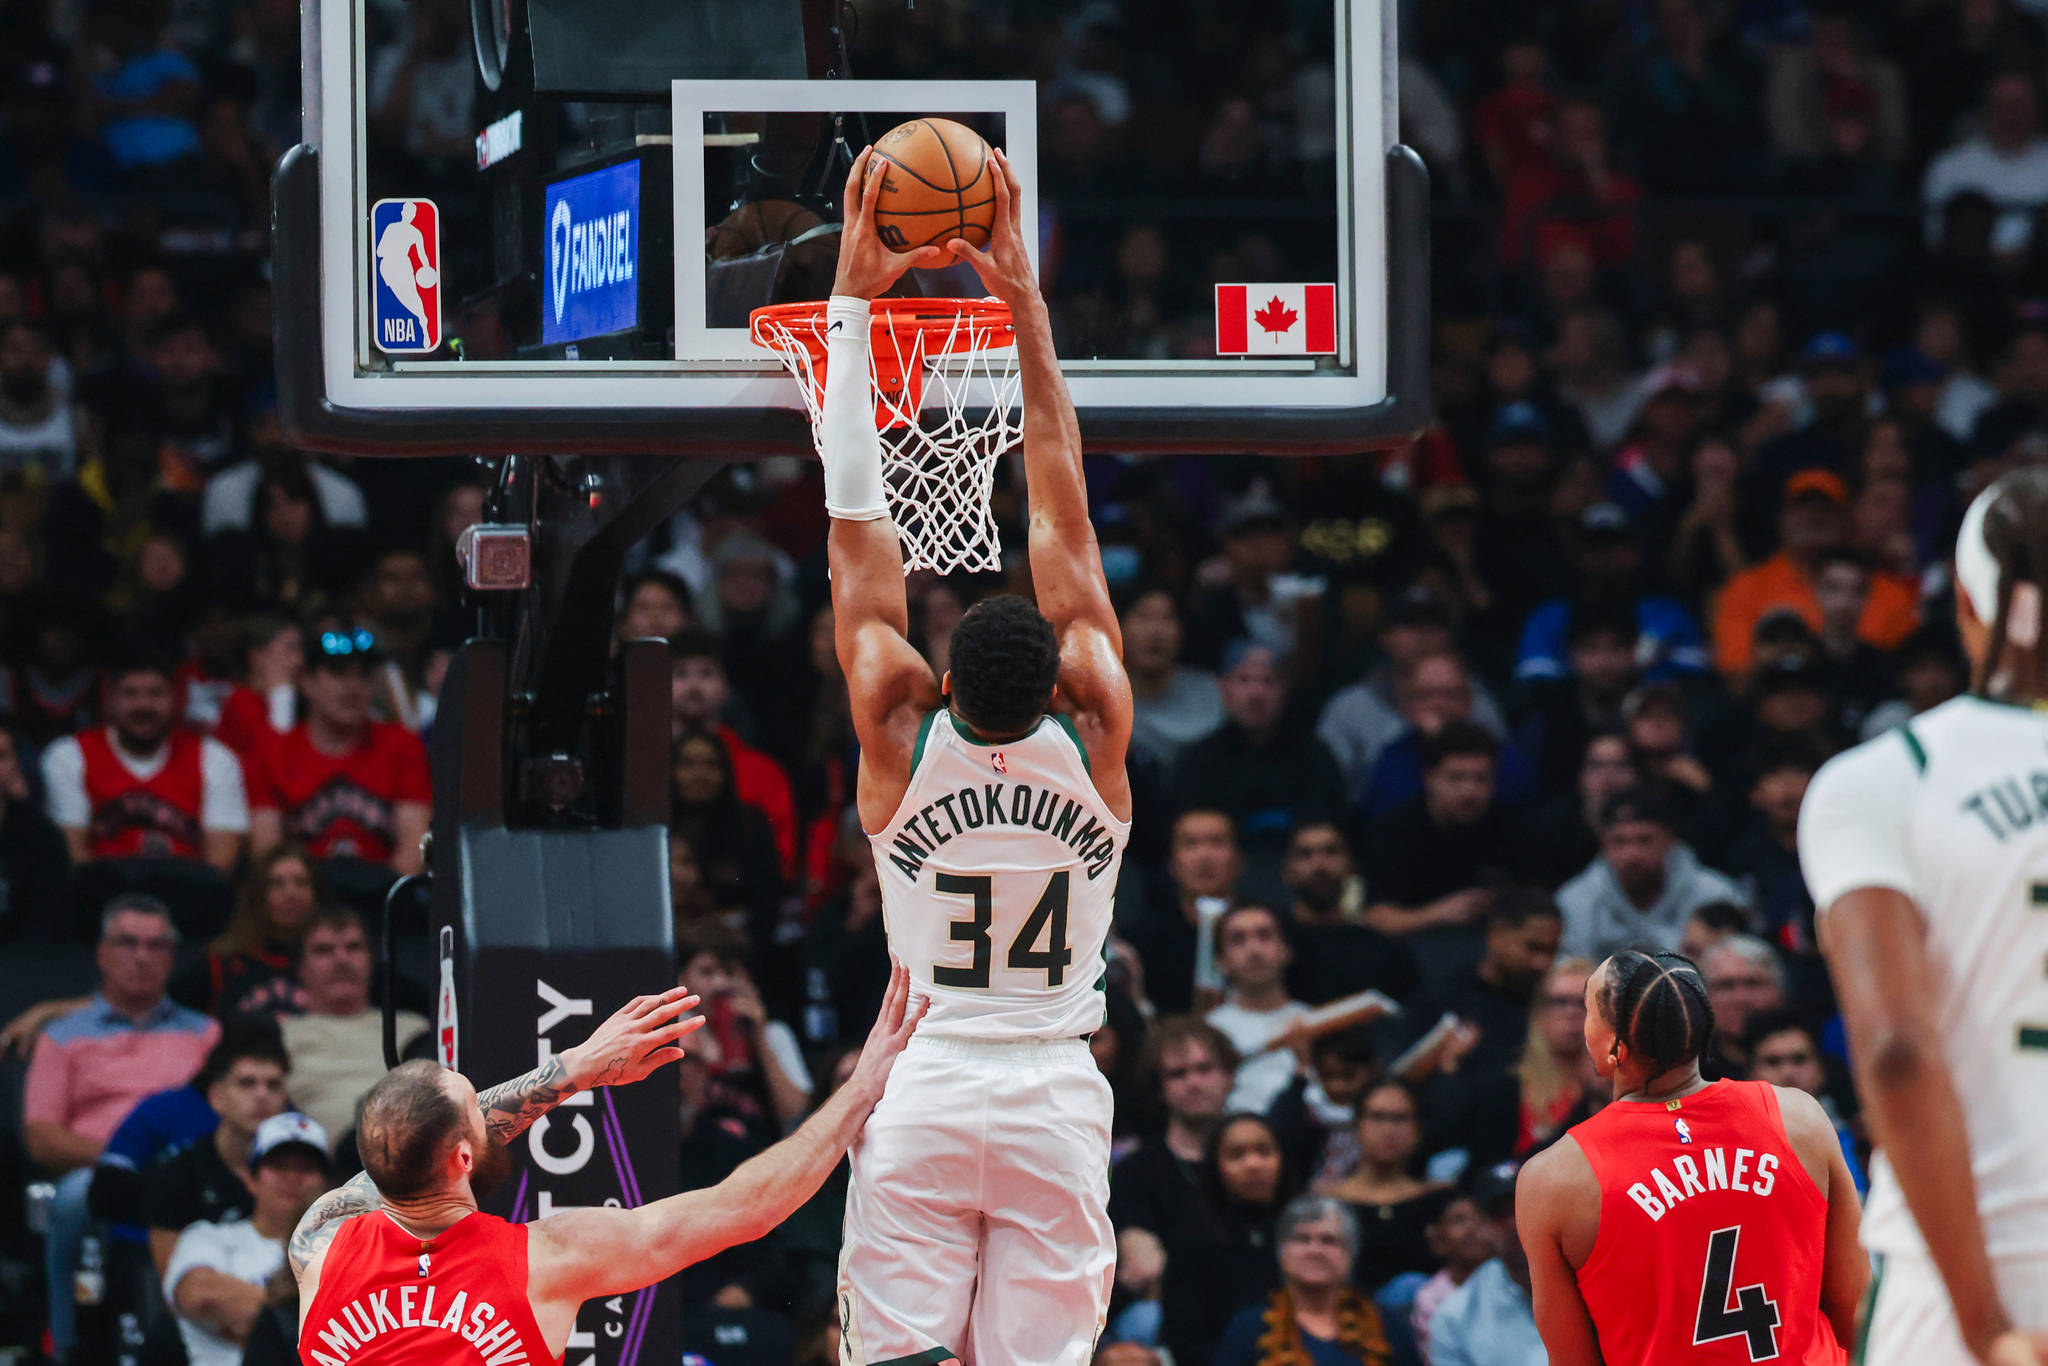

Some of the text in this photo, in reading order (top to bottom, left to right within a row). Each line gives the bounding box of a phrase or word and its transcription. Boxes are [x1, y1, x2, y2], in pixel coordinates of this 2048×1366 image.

[571, 209, 633, 294] FANDUEL
[384, 318, 416, 343] NBA
[889, 783, 1114, 883] ANTETOKOUNMPO
[931, 870, 1073, 991] 34
[1626, 1147, 1779, 1222] BARNES
[311, 1285, 530, 1366] AMUKELASHV
[1692, 1224, 1782, 1363] 4
